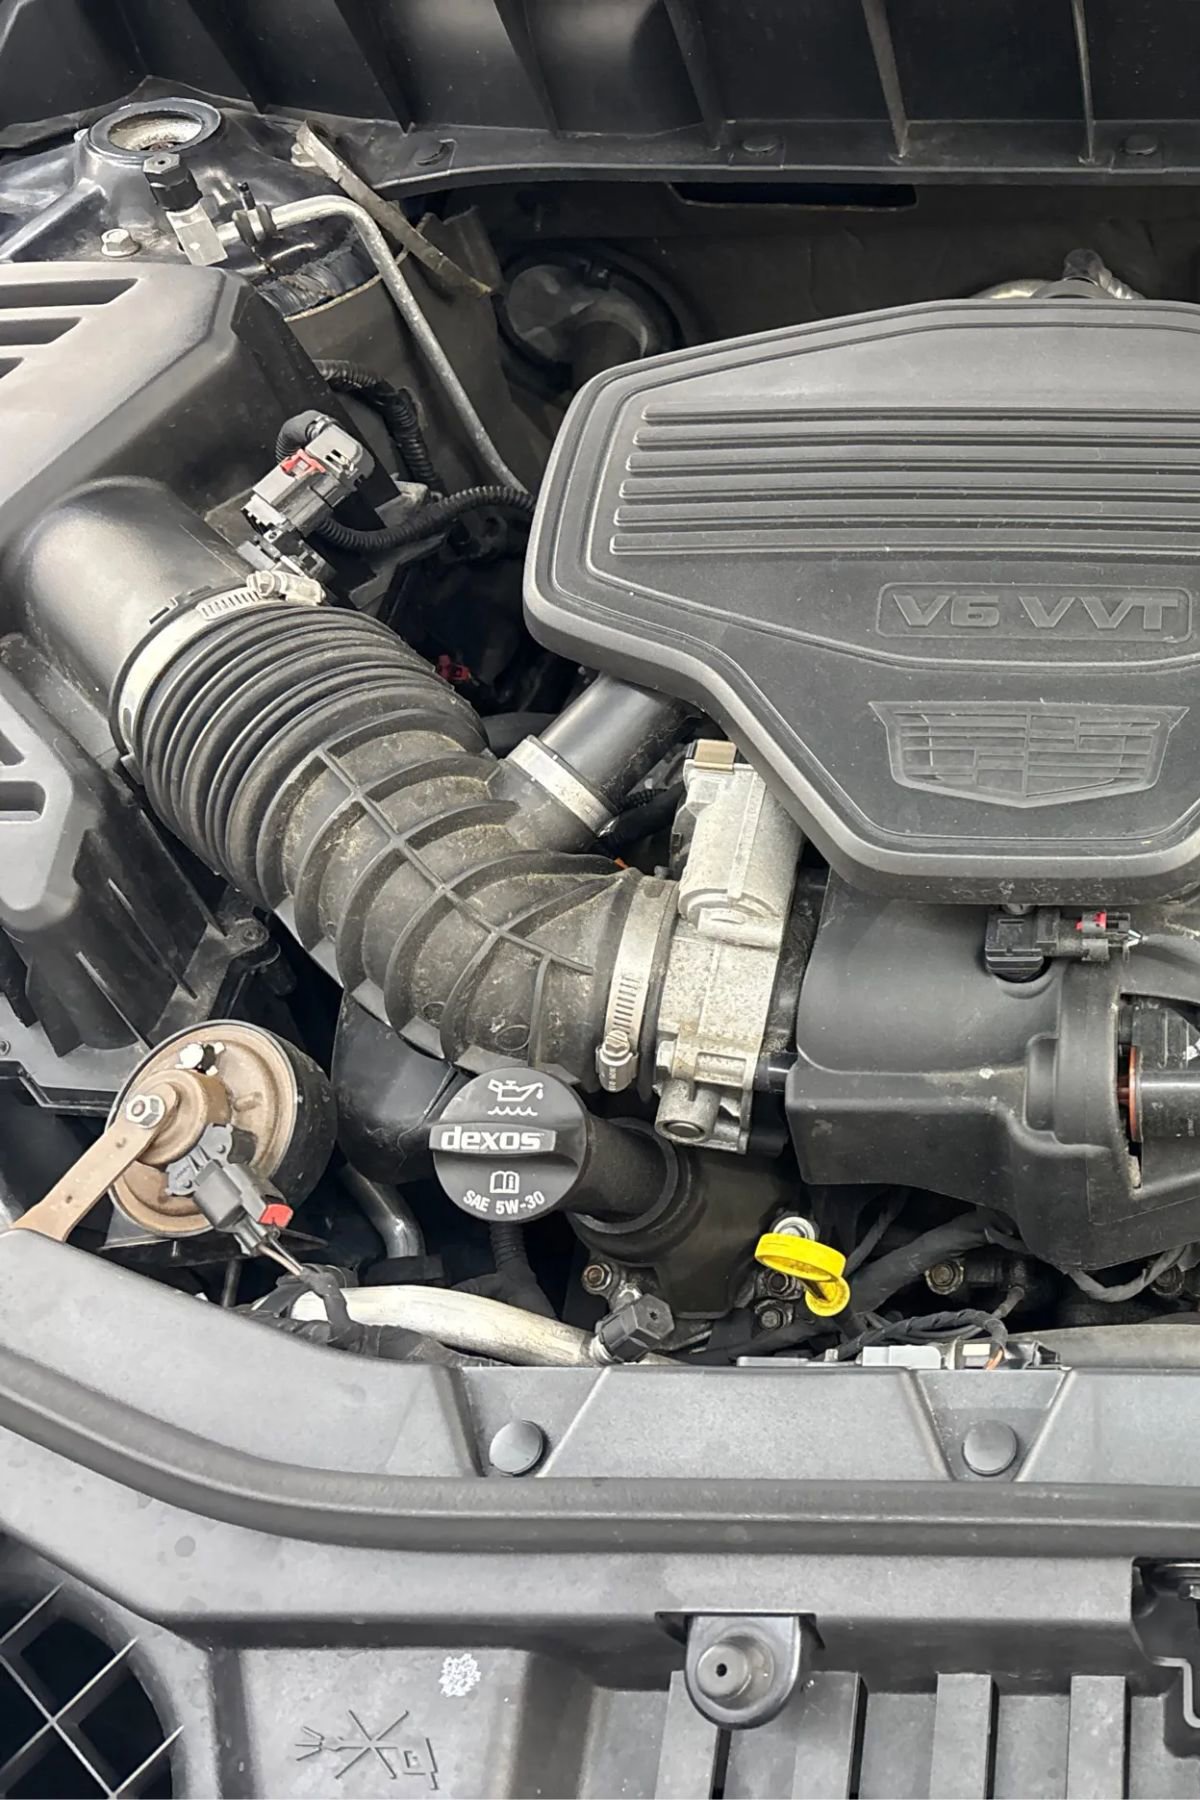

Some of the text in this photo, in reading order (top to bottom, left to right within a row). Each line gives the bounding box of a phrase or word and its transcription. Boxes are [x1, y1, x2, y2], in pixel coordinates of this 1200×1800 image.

[893, 594, 1179, 631] V6 VVT
[441, 1126, 541, 1150] dexos
[463, 1190, 545, 1214] SAE 5W-30
